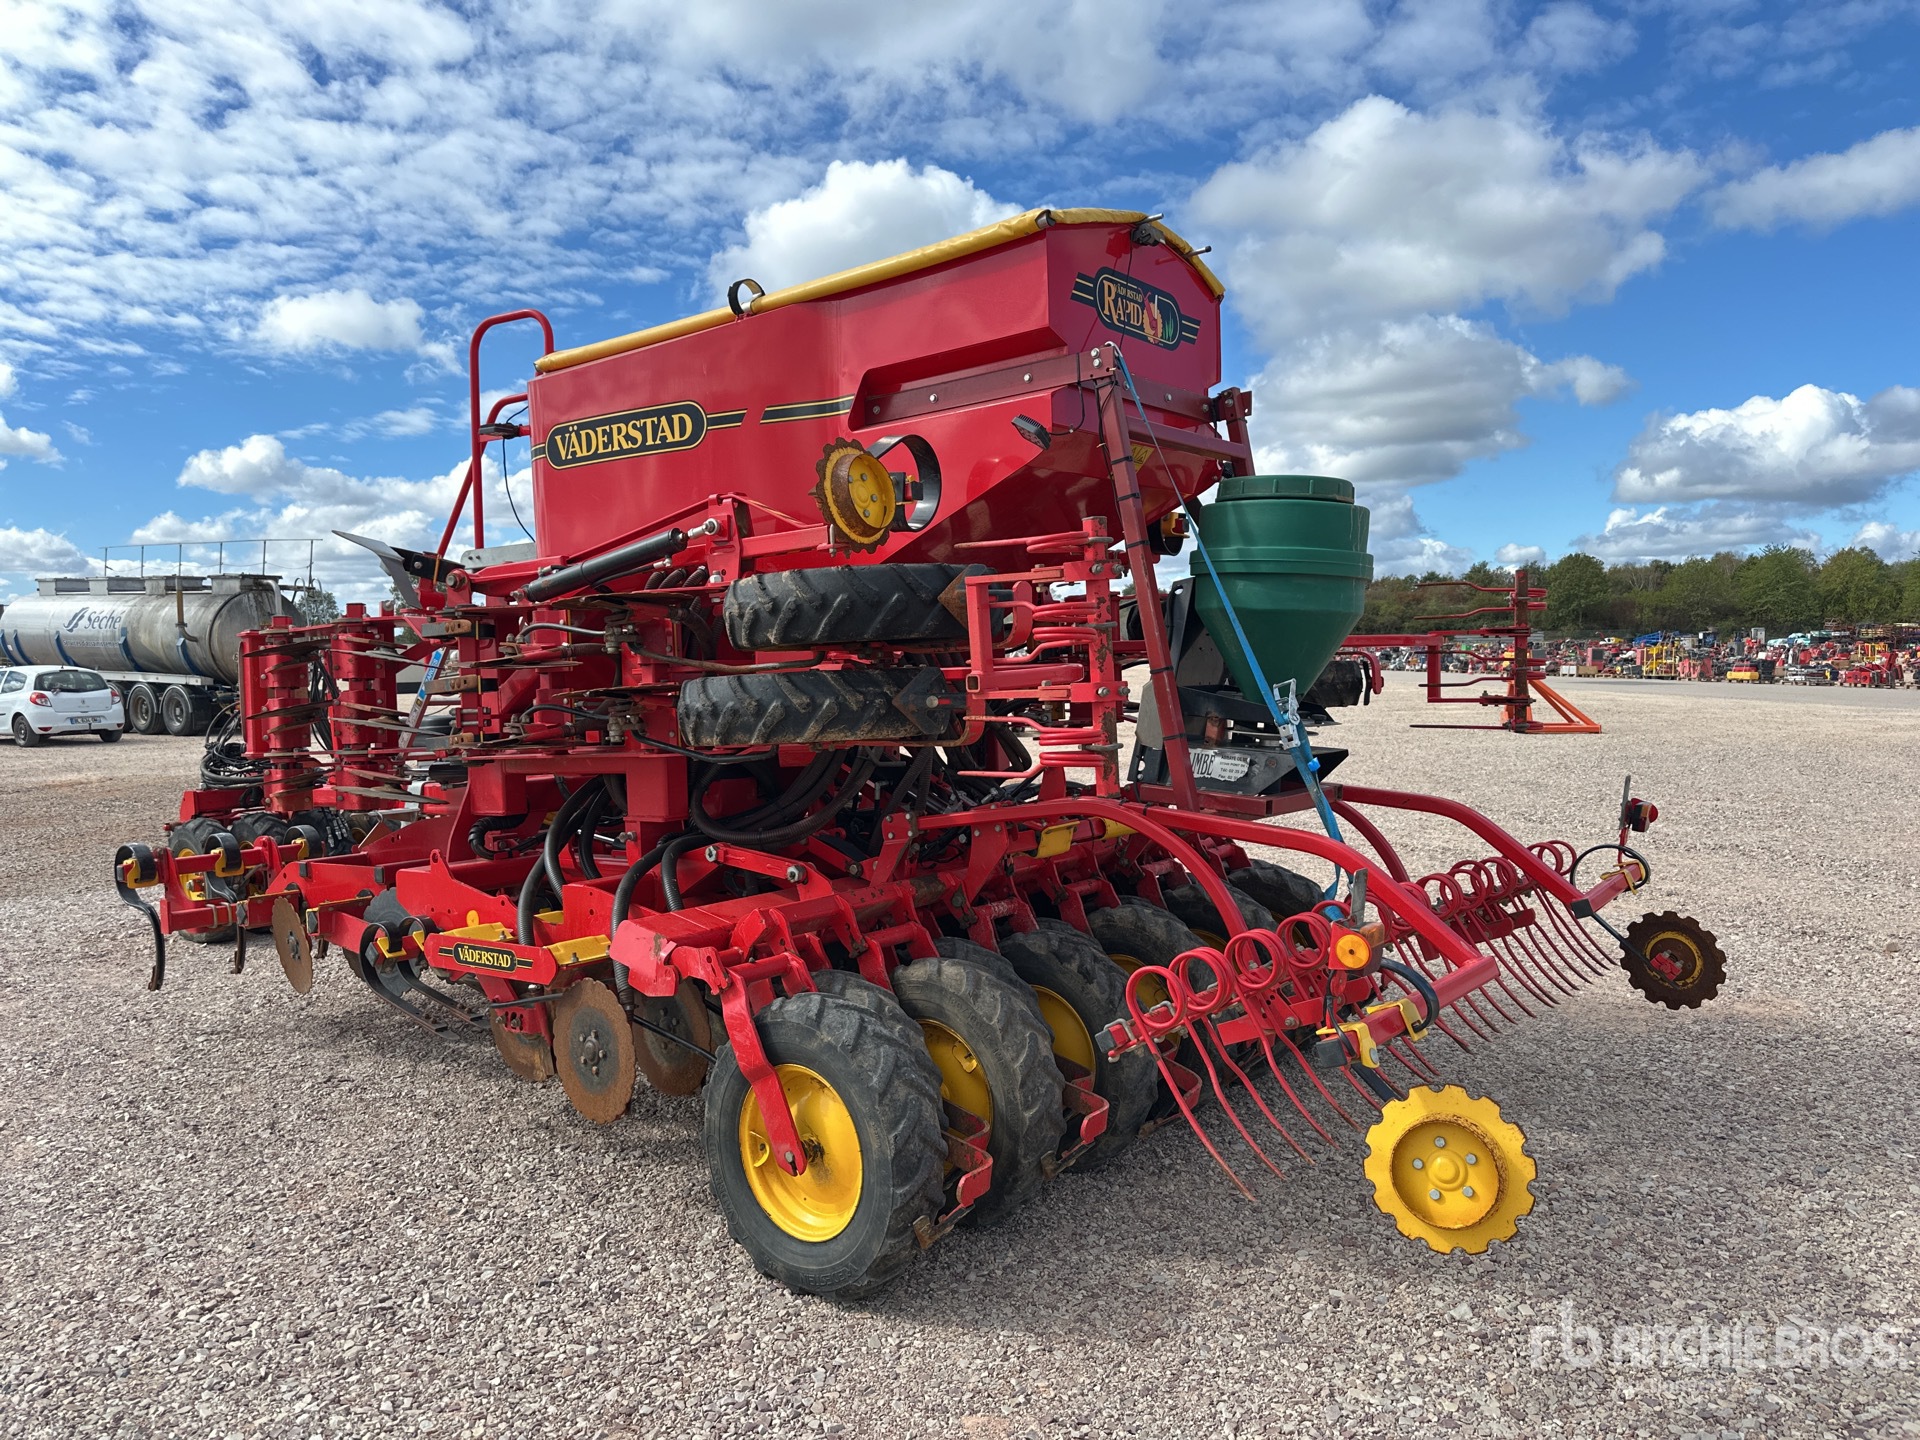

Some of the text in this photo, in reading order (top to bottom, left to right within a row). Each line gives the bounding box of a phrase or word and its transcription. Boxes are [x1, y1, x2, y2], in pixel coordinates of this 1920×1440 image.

[1102, 279, 1143, 327] RAPID
[554, 412, 693, 460] VÄDERSTAD
[84, 610, 126, 630] Séché
[457, 945, 511, 968] VÄDERSTAD
